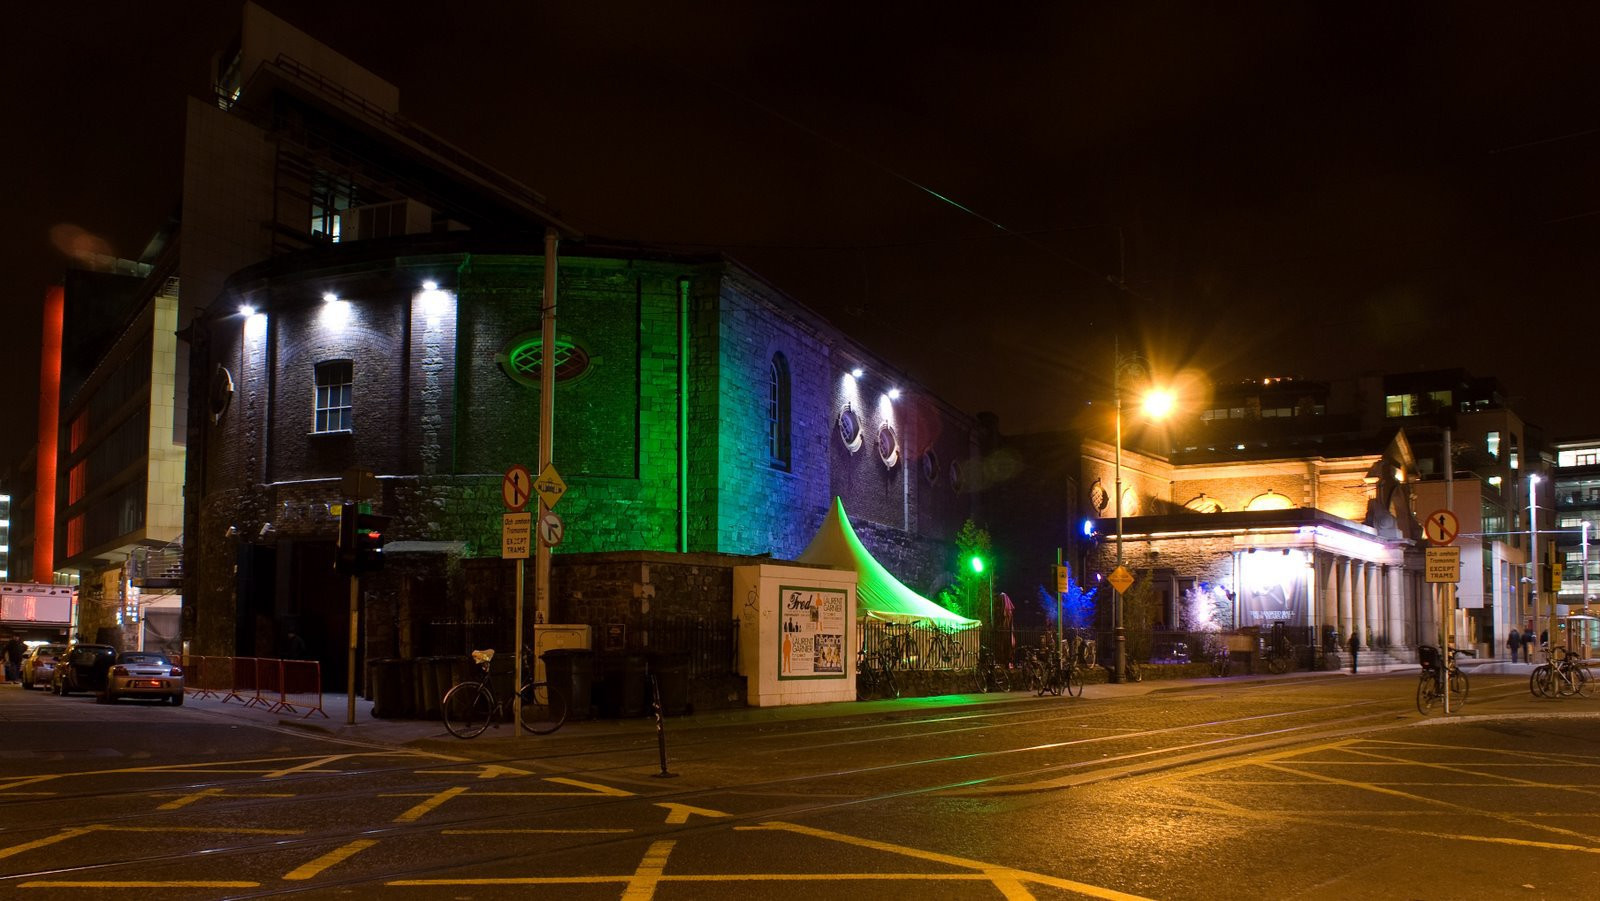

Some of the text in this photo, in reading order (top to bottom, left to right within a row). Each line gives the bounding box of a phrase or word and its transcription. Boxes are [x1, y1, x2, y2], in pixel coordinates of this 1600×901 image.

[506, 537, 527, 545] EXCEPT
[507, 546, 526, 554] TRAMS
[787, 592, 813, 610] Fred
[824, 595, 843, 604] LAURENT
[824, 604, 842, 612] GARNIER
[792, 637, 813, 645] LAURENT
[792, 645, 813, 653] GARNIER
